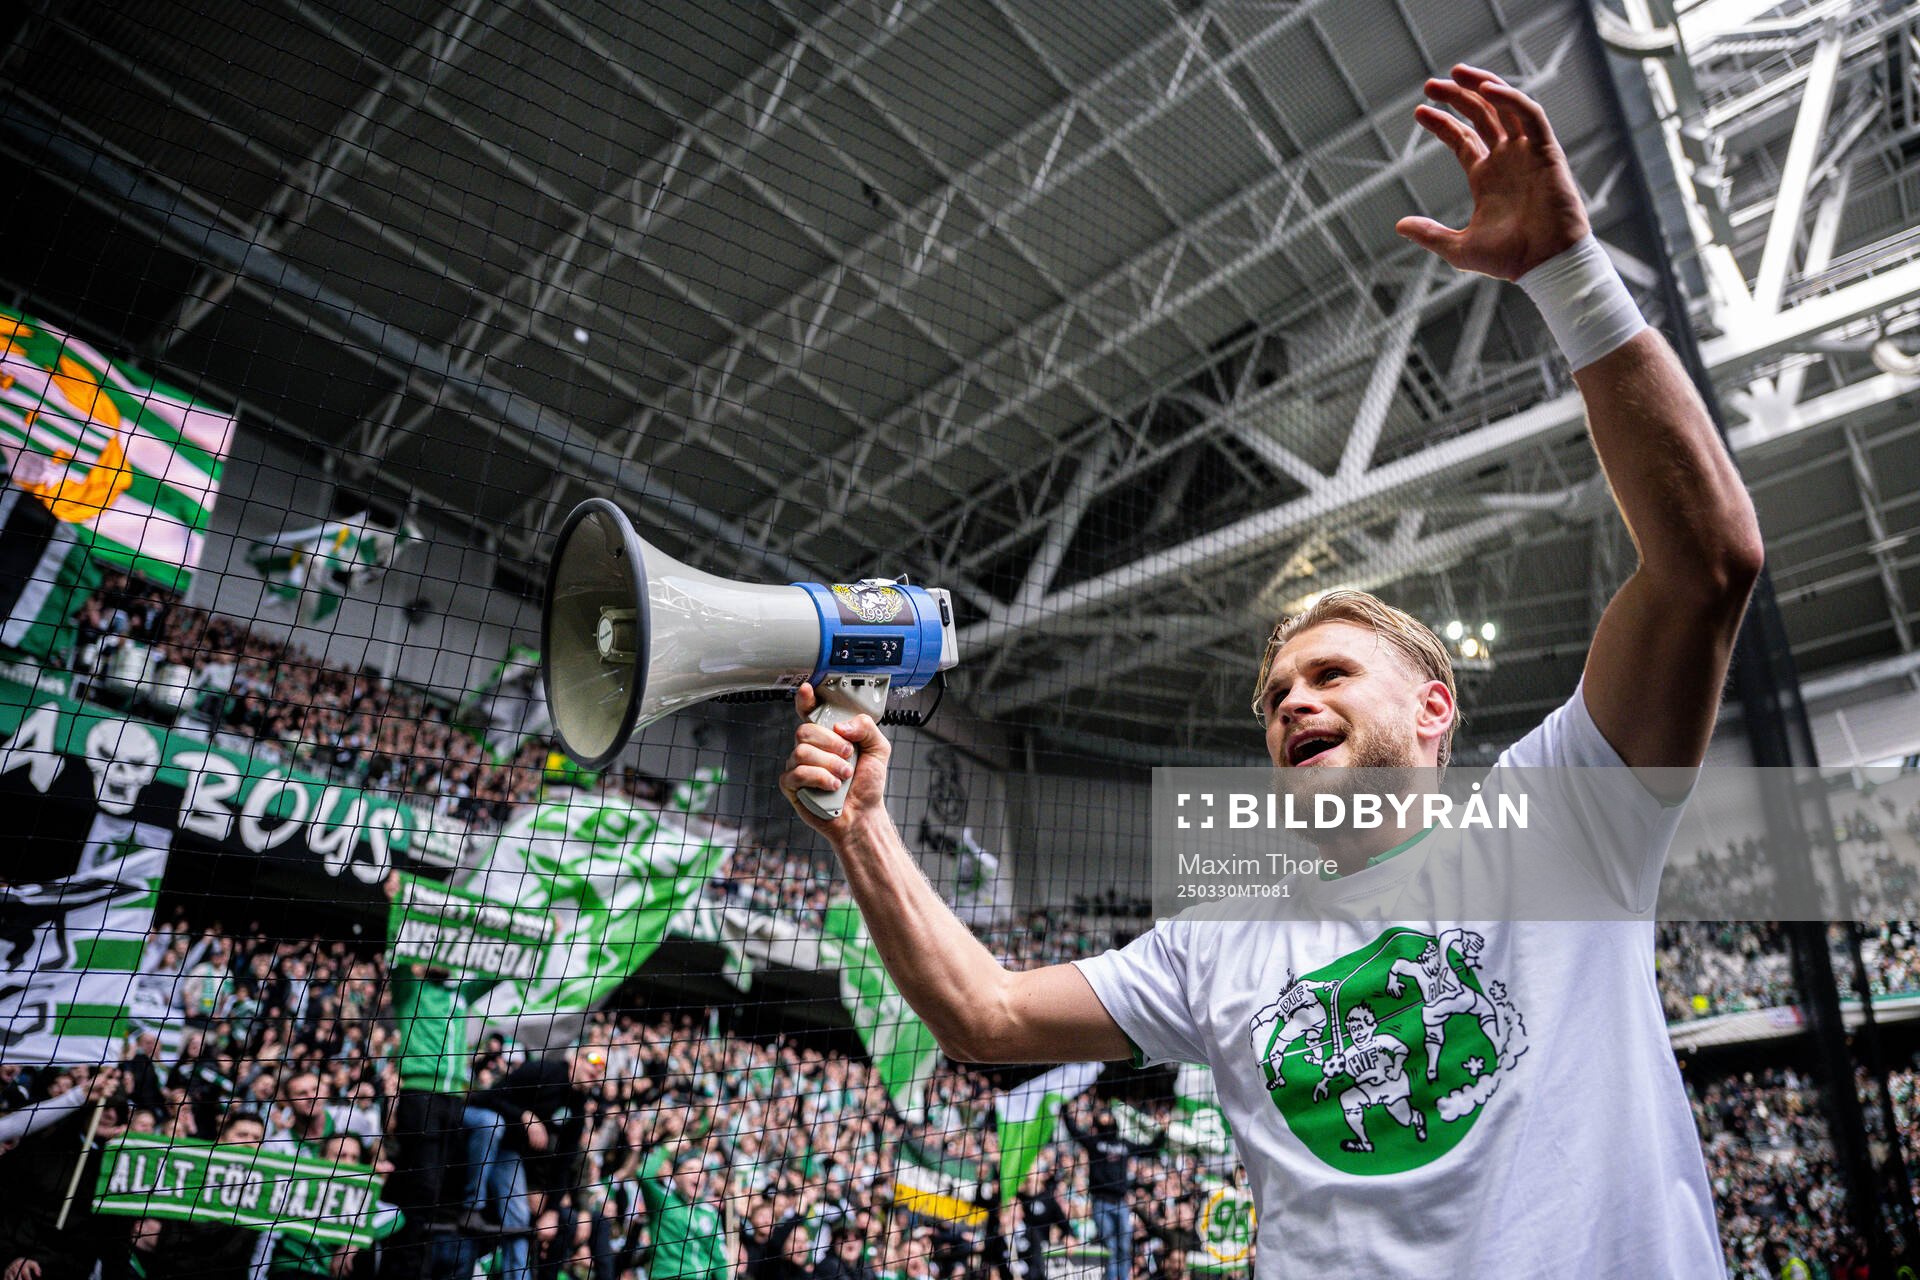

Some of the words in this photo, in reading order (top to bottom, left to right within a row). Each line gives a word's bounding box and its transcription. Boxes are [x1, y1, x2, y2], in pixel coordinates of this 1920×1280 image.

[861, 607, 891, 621] 1993
[172, 751, 404, 884] BOYS
[1279, 985, 1304, 1014] DIF
[1428, 966, 1458, 1002] AK
[1348, 1048, 1379, 1077] HIF
[107, 1153, 194, 1199] ALLT
[203, 1162, 264, 1210] FÖR
